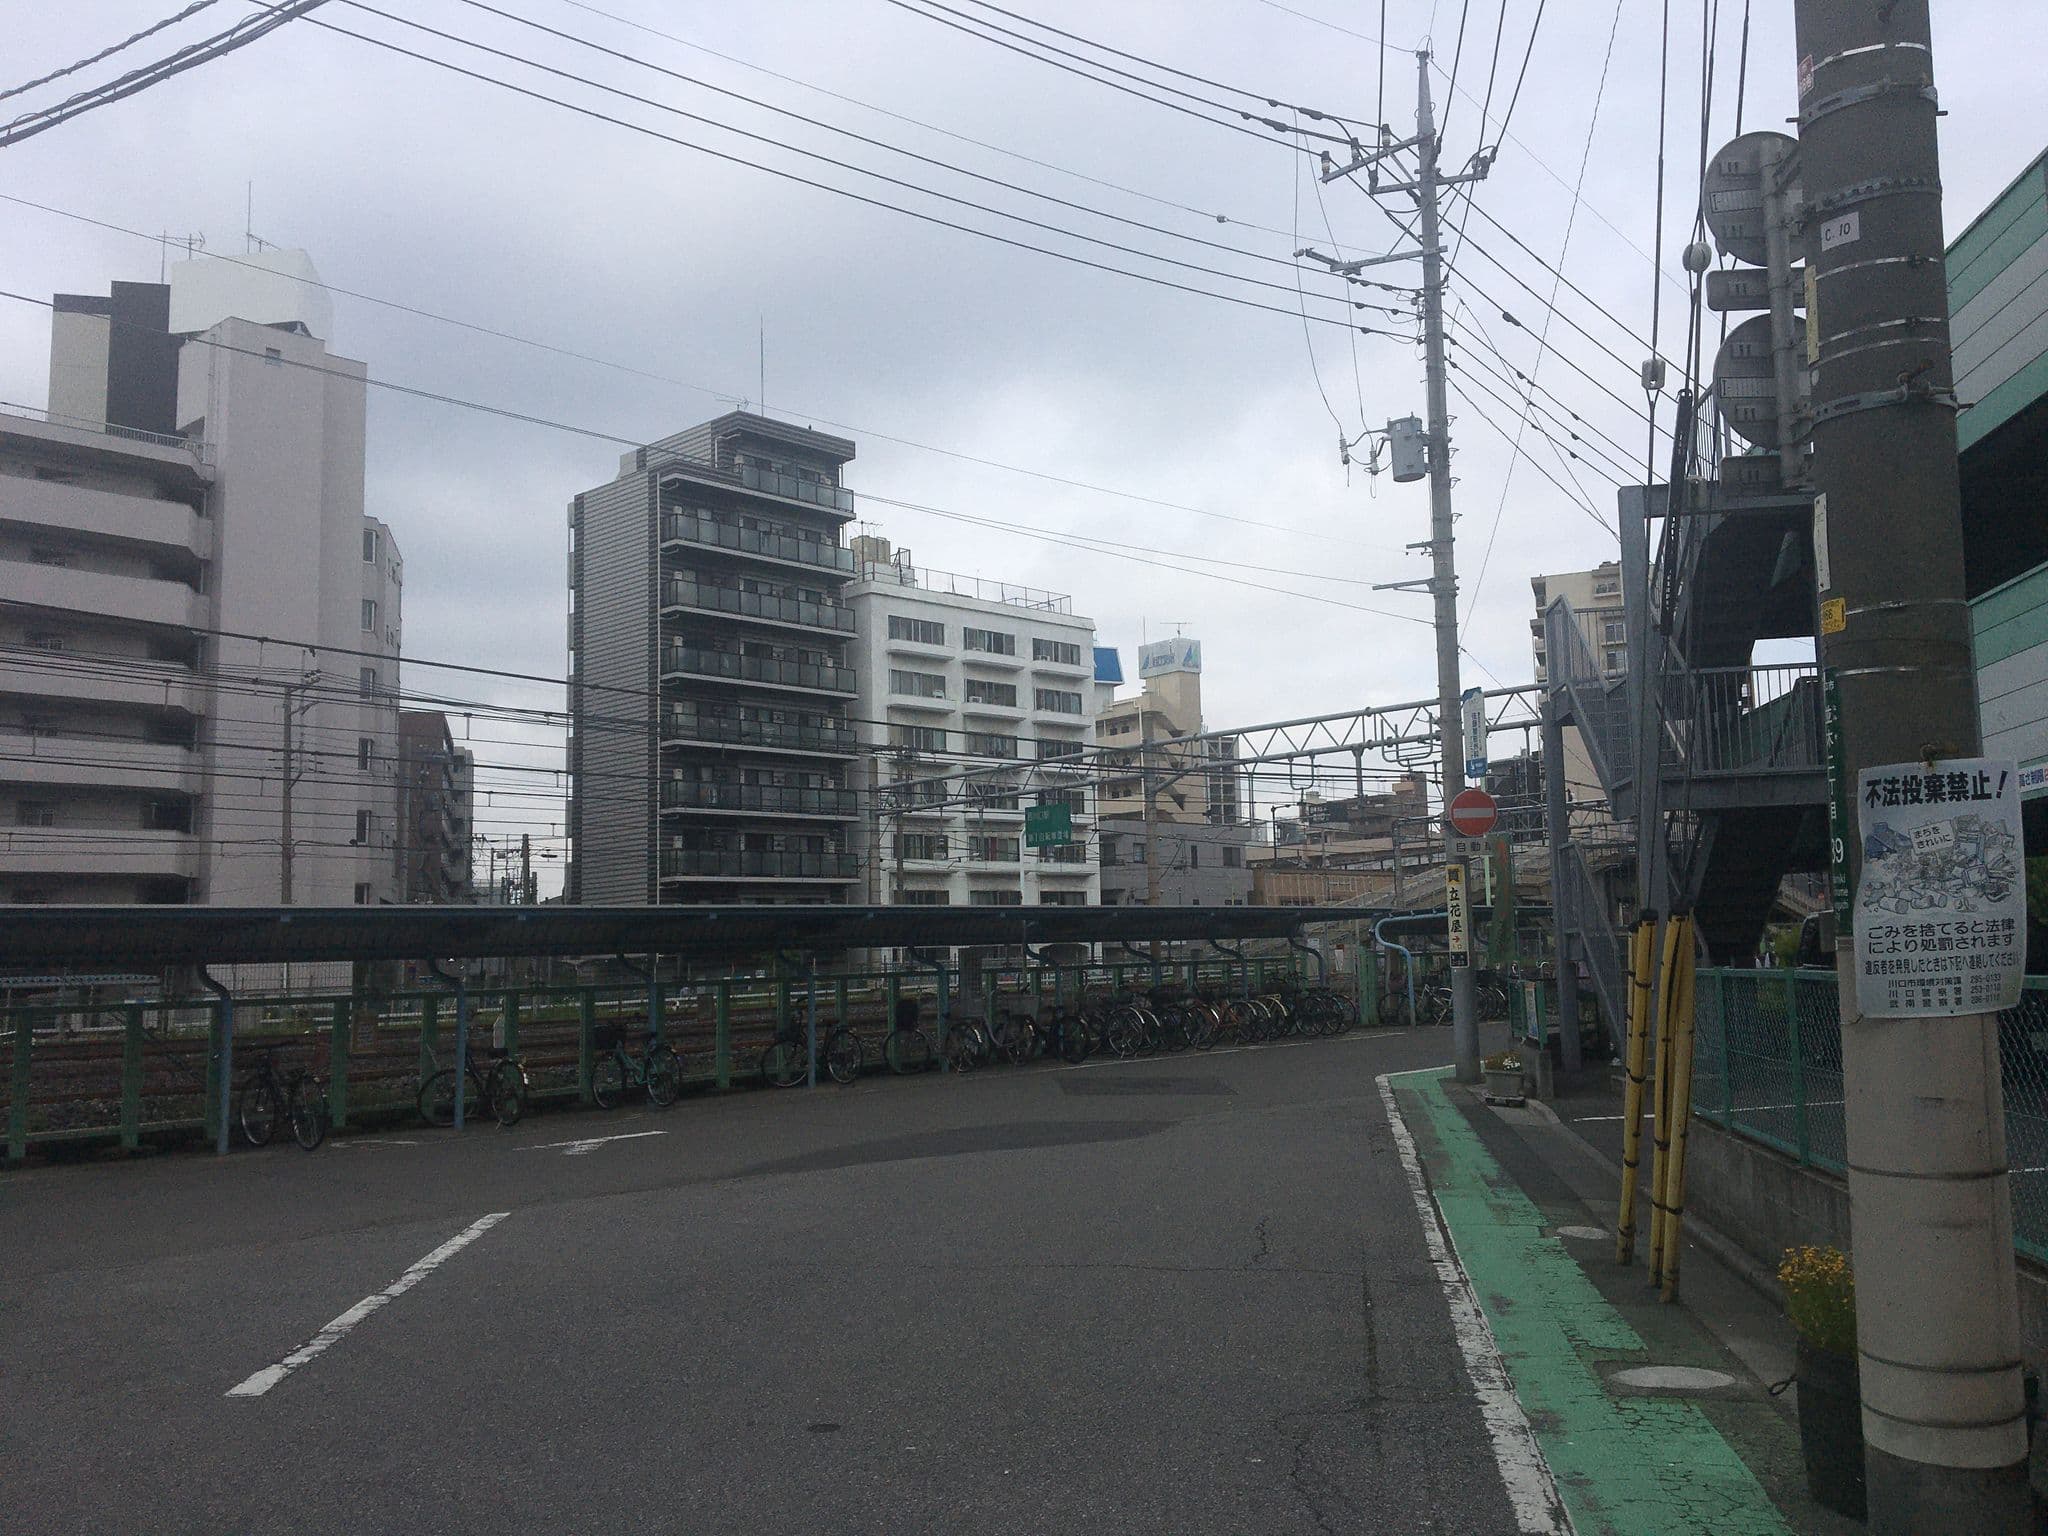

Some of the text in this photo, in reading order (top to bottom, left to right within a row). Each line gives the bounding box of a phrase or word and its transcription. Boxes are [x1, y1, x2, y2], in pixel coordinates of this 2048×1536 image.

[1865, 769, 2008, 809] 不法投棄禁止!
[1449, 887, 1462, 933] 立花屋
[1868, 918, 2015, 940] ごみを捨てると法律
[1868, 933, 2015, 955] により処罰されます
